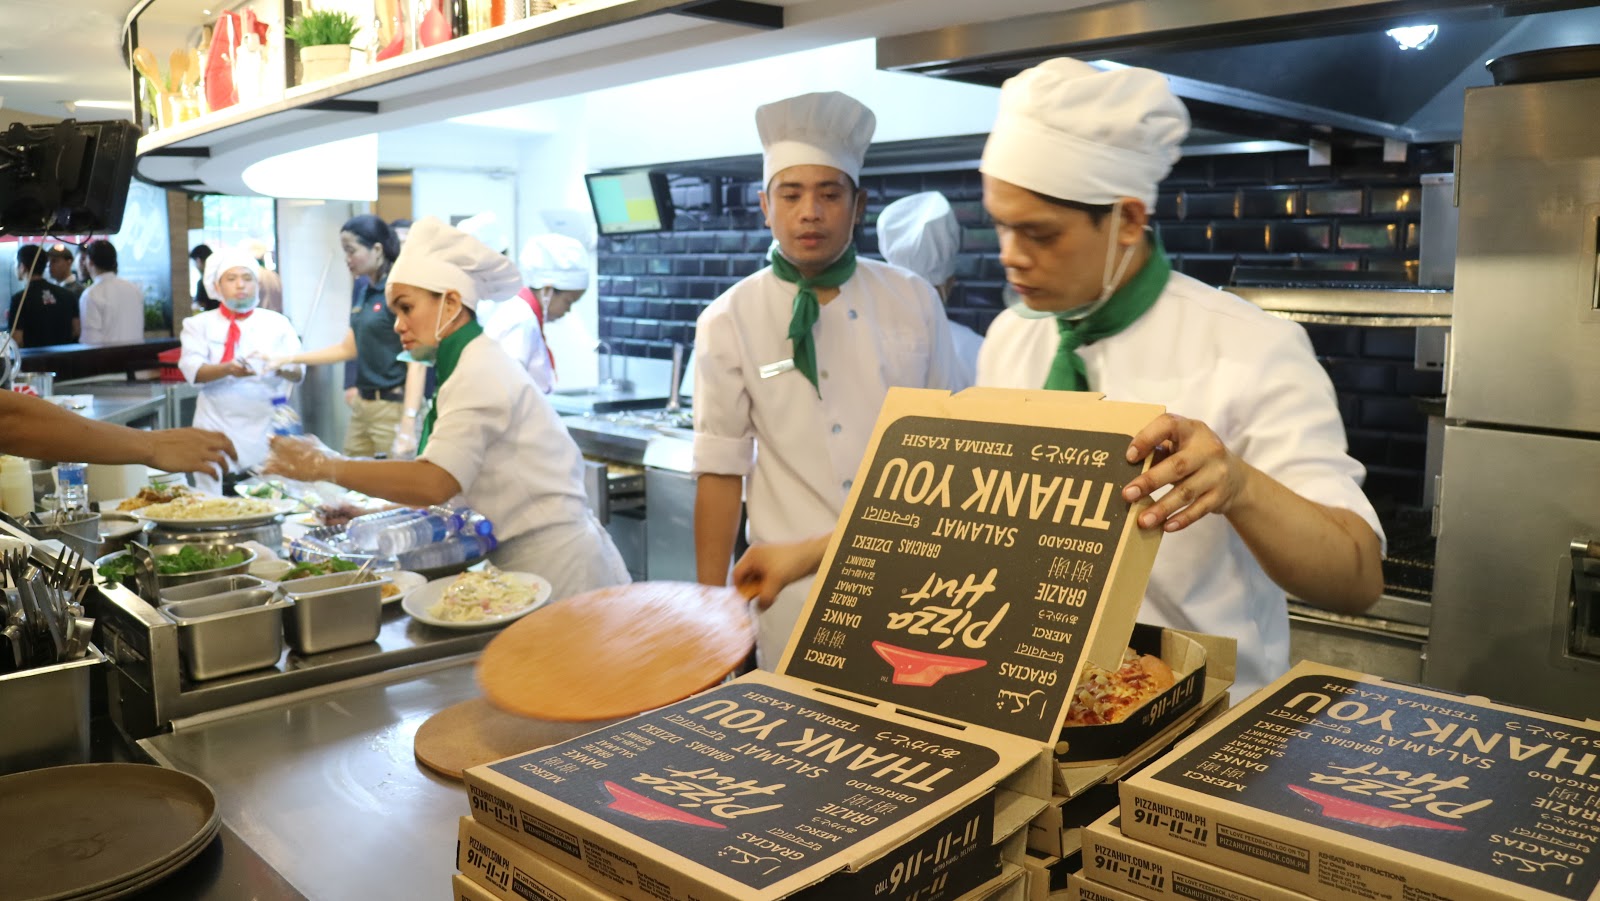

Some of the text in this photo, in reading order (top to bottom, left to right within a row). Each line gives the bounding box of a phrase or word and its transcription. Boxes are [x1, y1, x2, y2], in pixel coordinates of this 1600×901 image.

[901, 434, 1013, 457] TERIMA KASIH
[1031, 444, 1109, 468] ありがとう
[873, 457, 1114, 530] THANK YOU
[851, 535, 893, 553] DZIEKI
[931, 517, 1018, 547] SALAMAT
[1038, 534, 1103, 554] OBRIGADO
[898, 539, 942, 558] GRACIAS
[845, 555, 876, 568] BEDANKT
[1048, 556, 1094, 583] 谢谢
[829, 592, 858, 608] GRAZIE
[835, 580, 874, 596] SALAMAT
[900, 568, 997, 609] Hut
[1034, 582, 1087, 607] GRAZIE
[821, 608, 862, 628] DANKE
[887, 602, 1010, 649] Pizza
[1038, 609, 1079, 625] ありがとう
[813, 626, 846, 649] 谢谢
[1032, 627, 1072, 644] MERCI
[804, 649, 846, 669] MERCI
[998, 662, 1057, 686] GRACIAS
[742, 691, 860, 732] TERIMA KASIH
[1150, 676, 1195, 726] 911-11-11
[637, 723, 685, 744] DZIEKI
[677, 700, 953, 792] THANK YOU
[562, 749, 608, 769] DANKE
[590, 740, 638, 758] SALAMAT
[685, 741, 735, 762] GRACIAS
[731, 743, 829, 778] SALAMAT
[1409, 717, 1600, 779] HANK
[519, 763, 566, 784] MERCI
[663, 768, 786, 800] Hut
[1528, 771, 1599, 792] RIGADO
[631, 772, 783, 819] Pizza
[845, 779, 917, 803] OBRIGADO
[472, 796, 518, 827] 911-11-11
[1135, 797, 1206, 827] PIZZAHUT.COM.PH
[1531, 797, 1600, 822] RAZIE
[795, 824, 842, 842] MERCI
[1134, 809, 1208, 842] 911-11-11
[737, 832, 804, 860] GRACIAS
[874, 815, 980, 896] CALL 911-11-11
[1220, 837, 1306, 870] PIZZAHUTFEEDBACK.COM.PH
[467, 850, 510, 886] 911-11-11
[1095, 844, 1163, 875] PIZZAHUT.COM.PH
[1095, 855, 1164, 888] 911-11-11
